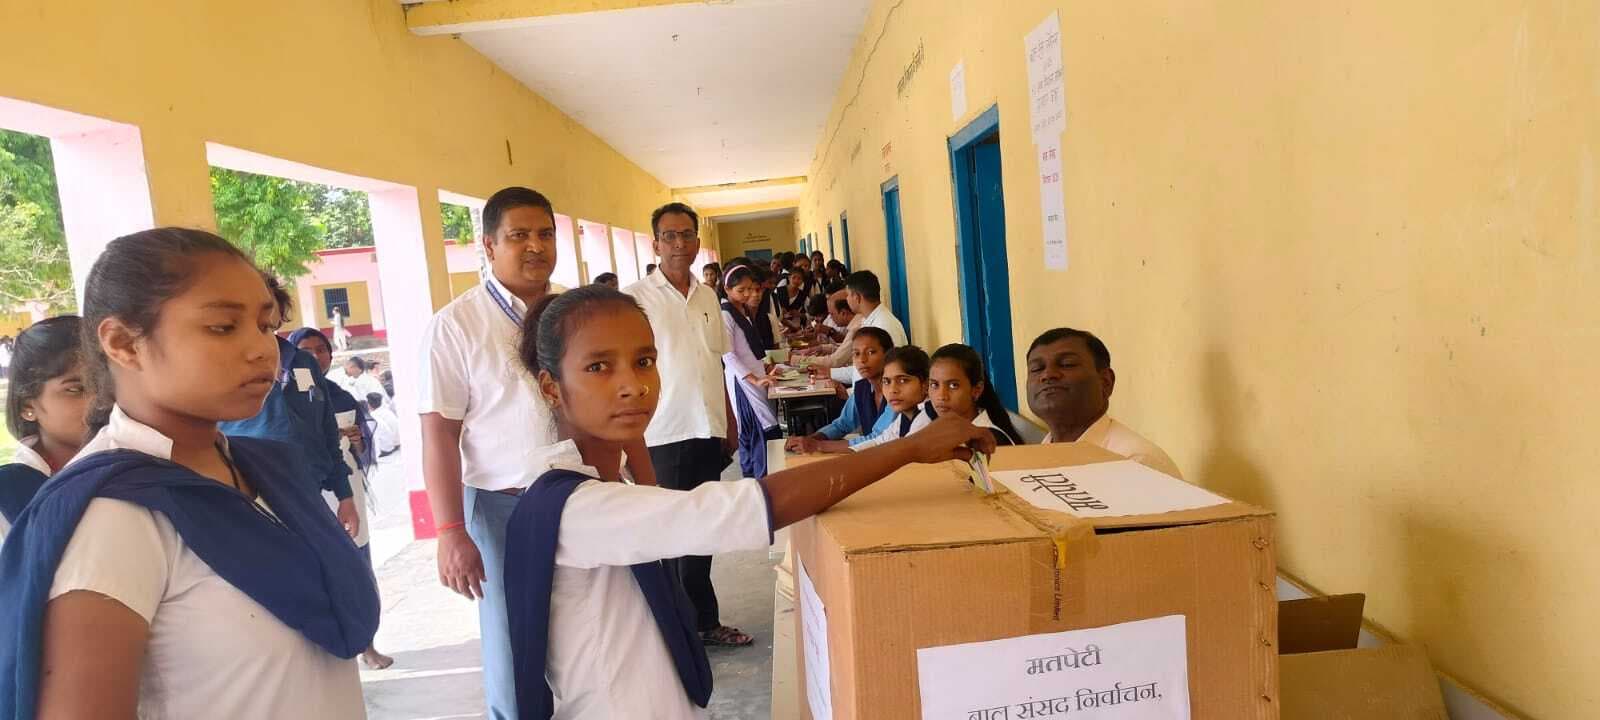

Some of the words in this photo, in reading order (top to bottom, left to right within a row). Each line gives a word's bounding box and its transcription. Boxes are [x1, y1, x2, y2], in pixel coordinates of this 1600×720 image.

[1020, 472, 1109, 512] मतपेटी
[1026, 644, 1101, 675] मतपेटी
[1016, 696, 1070, 719] संसद
